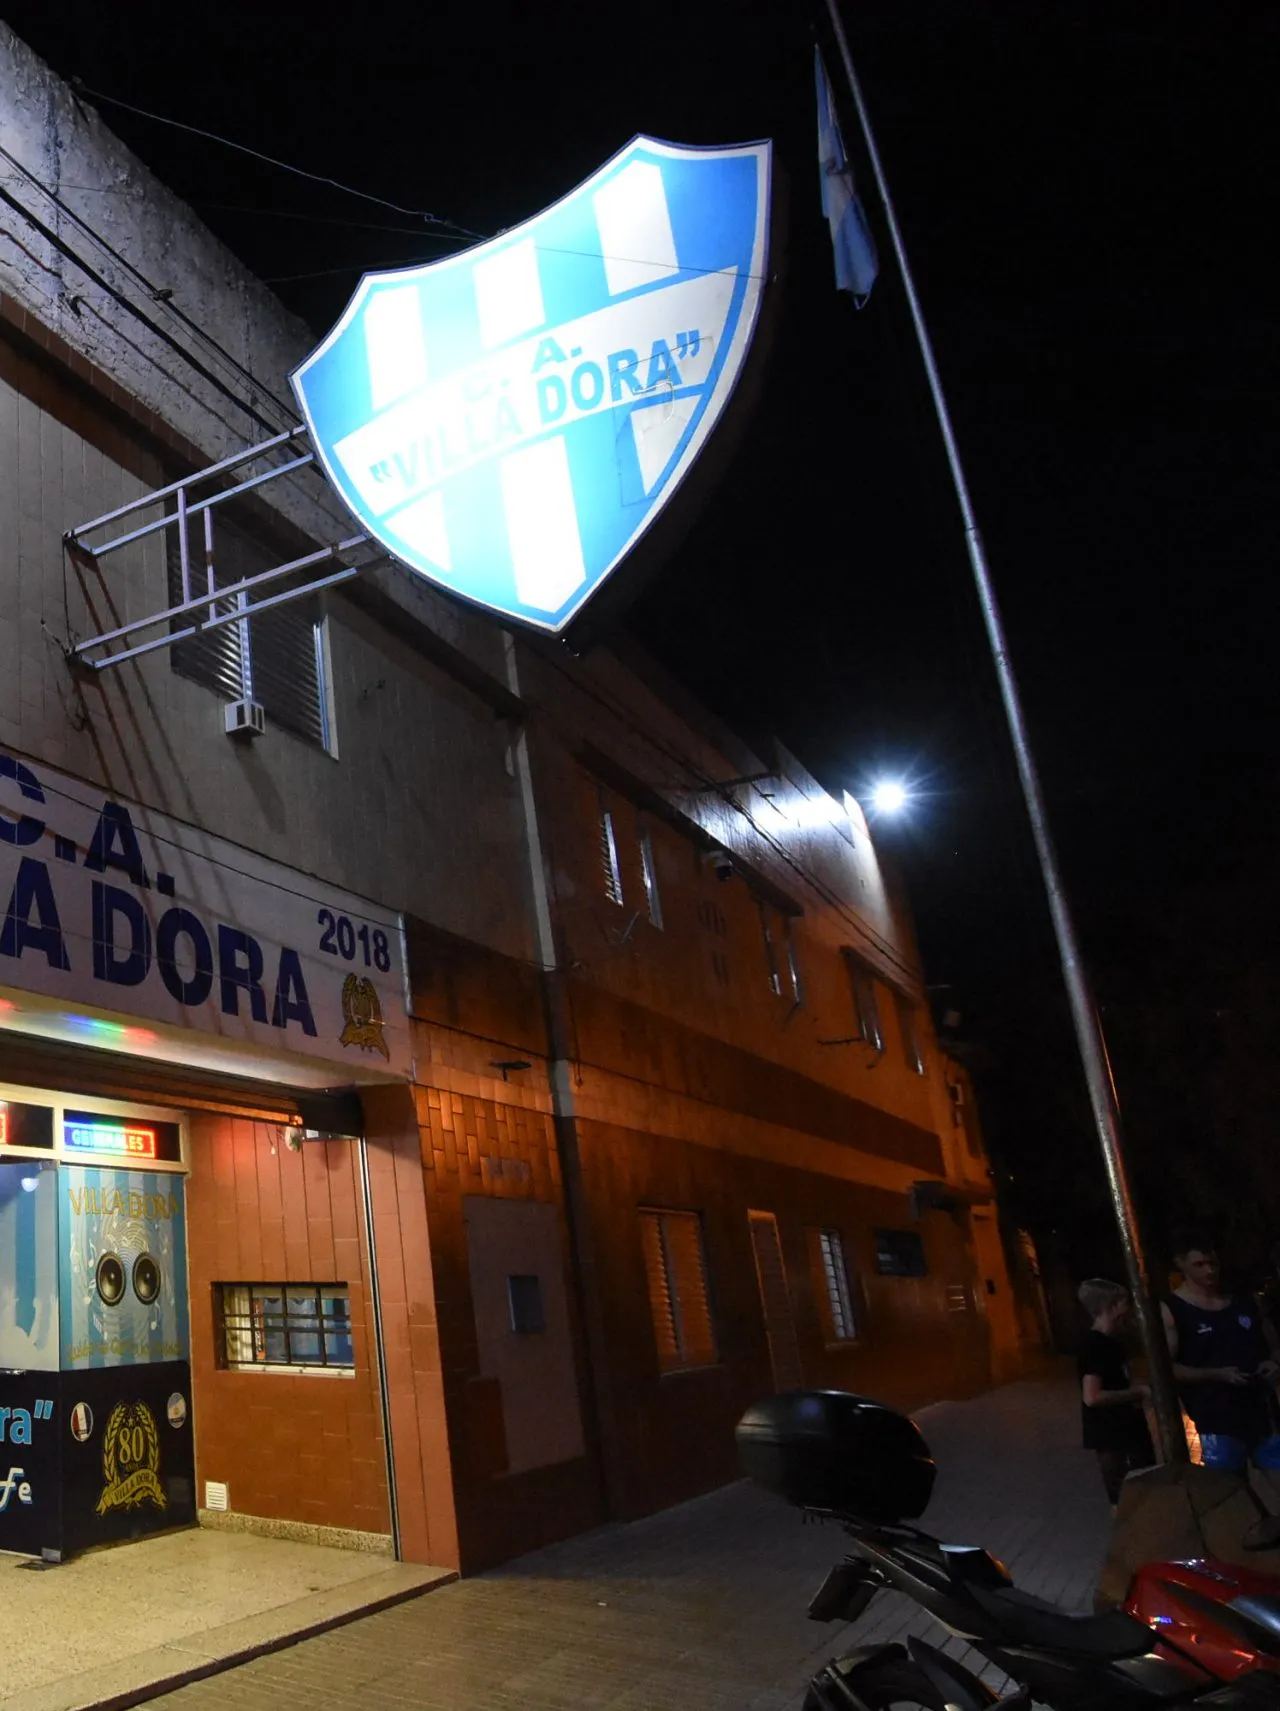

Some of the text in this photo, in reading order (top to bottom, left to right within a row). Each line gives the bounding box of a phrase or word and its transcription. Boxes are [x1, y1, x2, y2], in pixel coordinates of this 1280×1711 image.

[531, 336, 584, 374] A.
[91, 879, 318, 1038] DORA
[317, 907, 391, 974] 2018
[68, 1186, 180, 1220] VILLA DORA
[119, 1426, 144, 1464] 80
